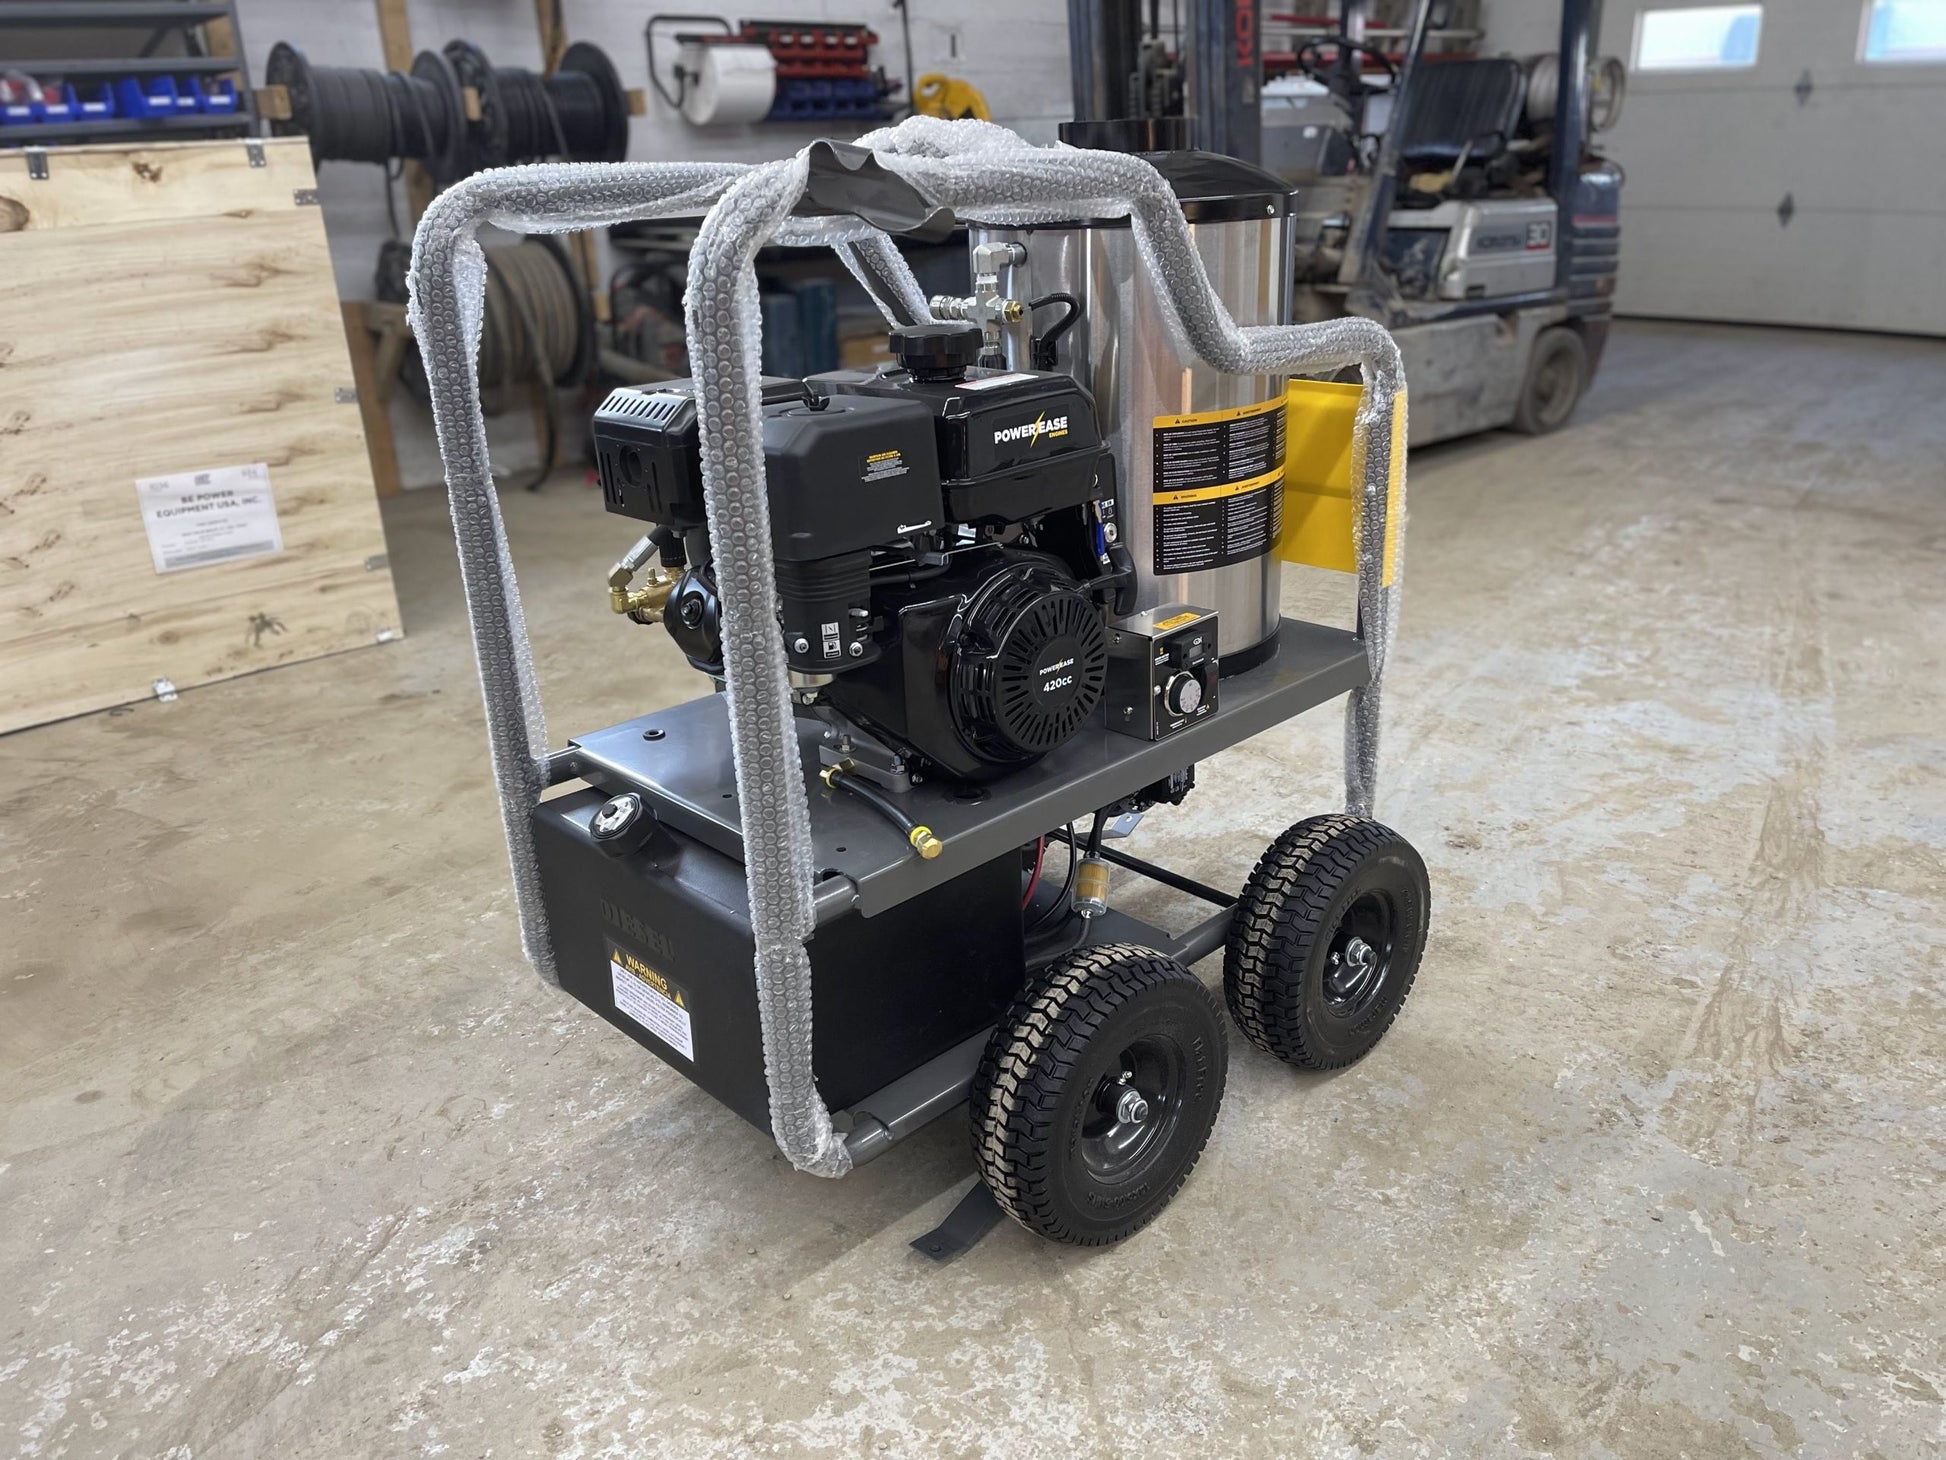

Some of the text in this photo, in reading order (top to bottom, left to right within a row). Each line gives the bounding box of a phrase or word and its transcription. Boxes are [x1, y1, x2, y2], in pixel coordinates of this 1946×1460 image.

[1235, 0, 1254, 66] KO
[1048, 429, 1068, 439] ENGINES
[197, 490, 234, 501] POWER
[156, 503, 214, 518] EQUIPMENT
[1043, 676, 1073, 692] 420cc
[625, 953, 668, 990] WARNING
